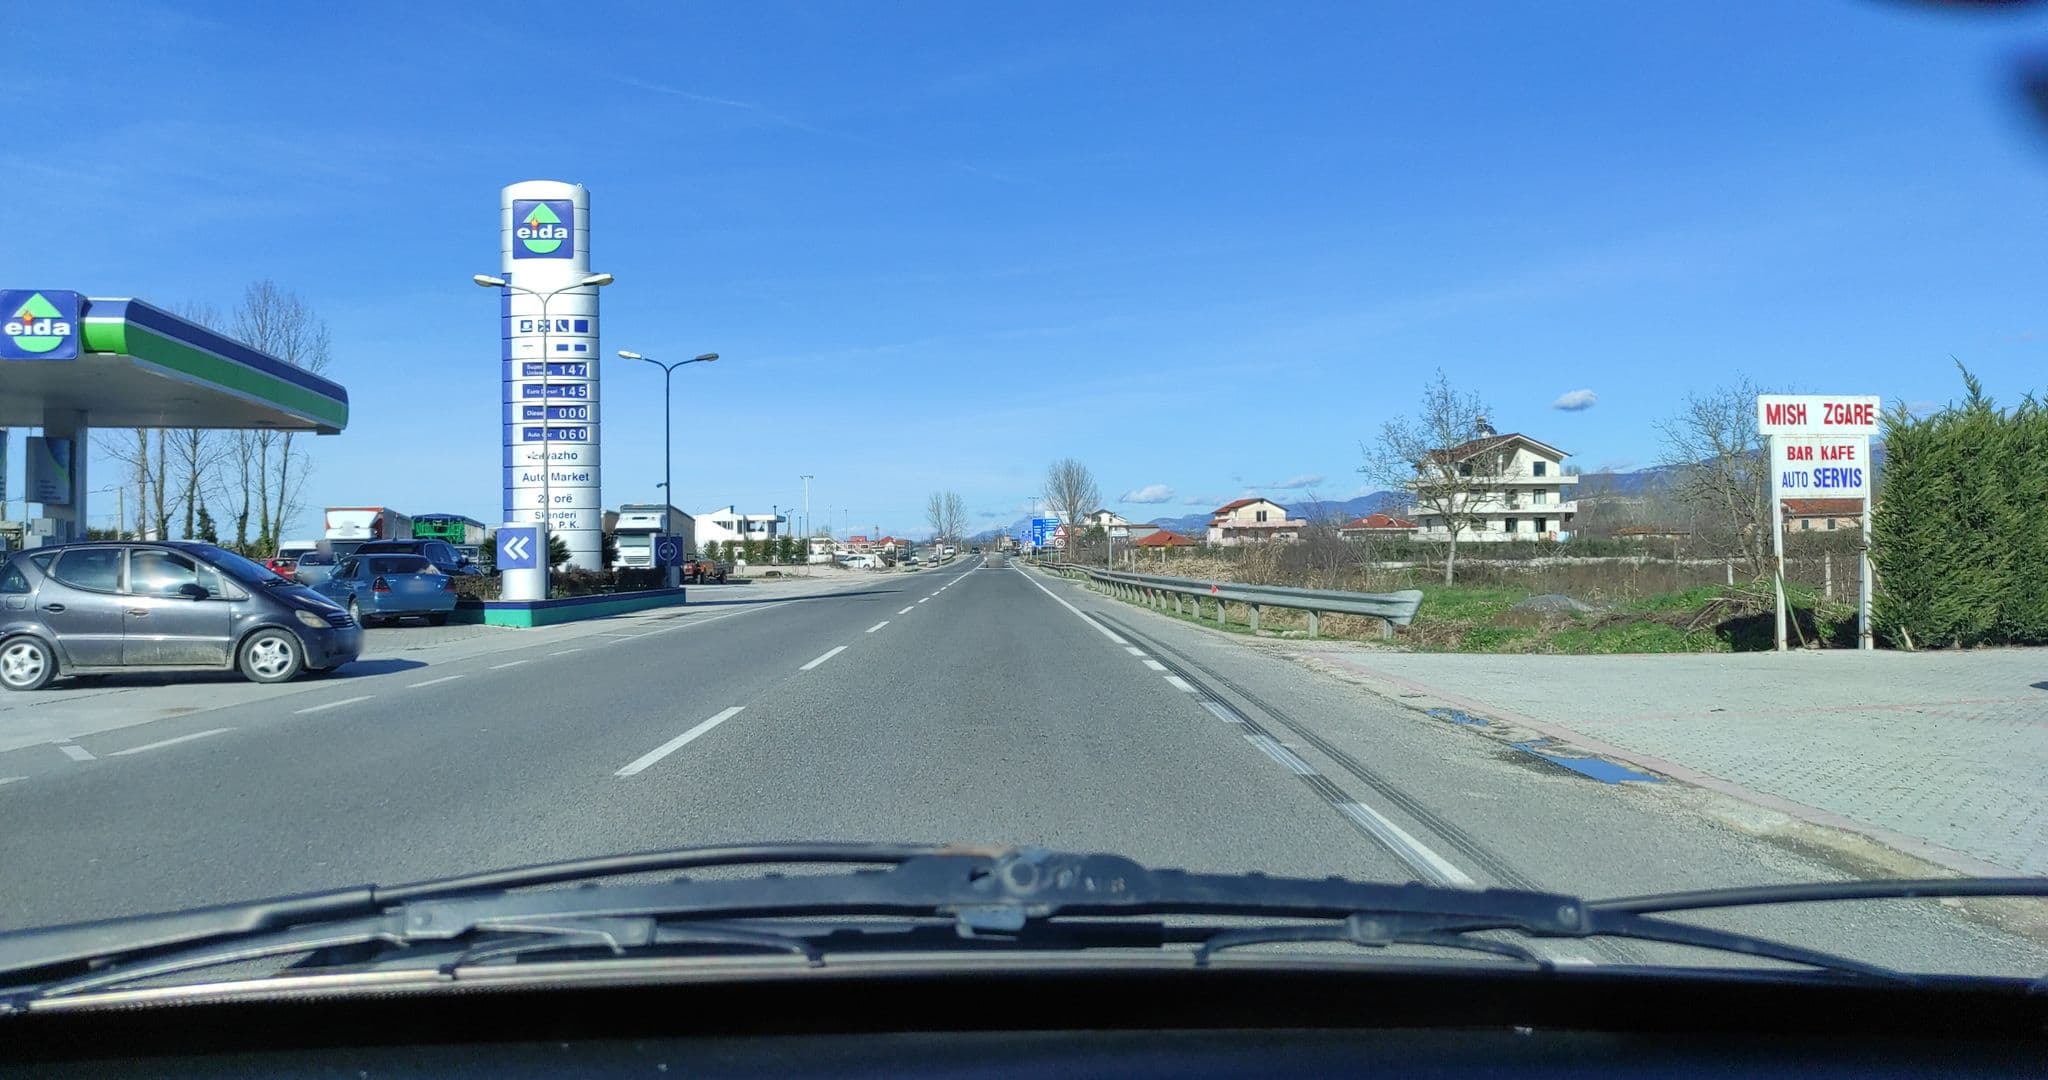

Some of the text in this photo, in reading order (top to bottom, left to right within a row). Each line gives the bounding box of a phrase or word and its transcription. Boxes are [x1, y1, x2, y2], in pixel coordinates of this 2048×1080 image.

[516, 223, 568, 239] eida
[4, 317, 71, 336] eida
[560, 365, 586, 375] 147
[560, 386, 586, 397] 145
[559, 408, 586, 418] 000
[1766, 403, 1874, 425] MISH ZGARE
[559, 429, 586, 440] 060
[1787, 445, 1855, 460] BAR KAFE
[551, 472, 590, 482] Market
[1782, 468, 1862, 488] AUTO SERVIS
[554, 493, 573, 503] orë
